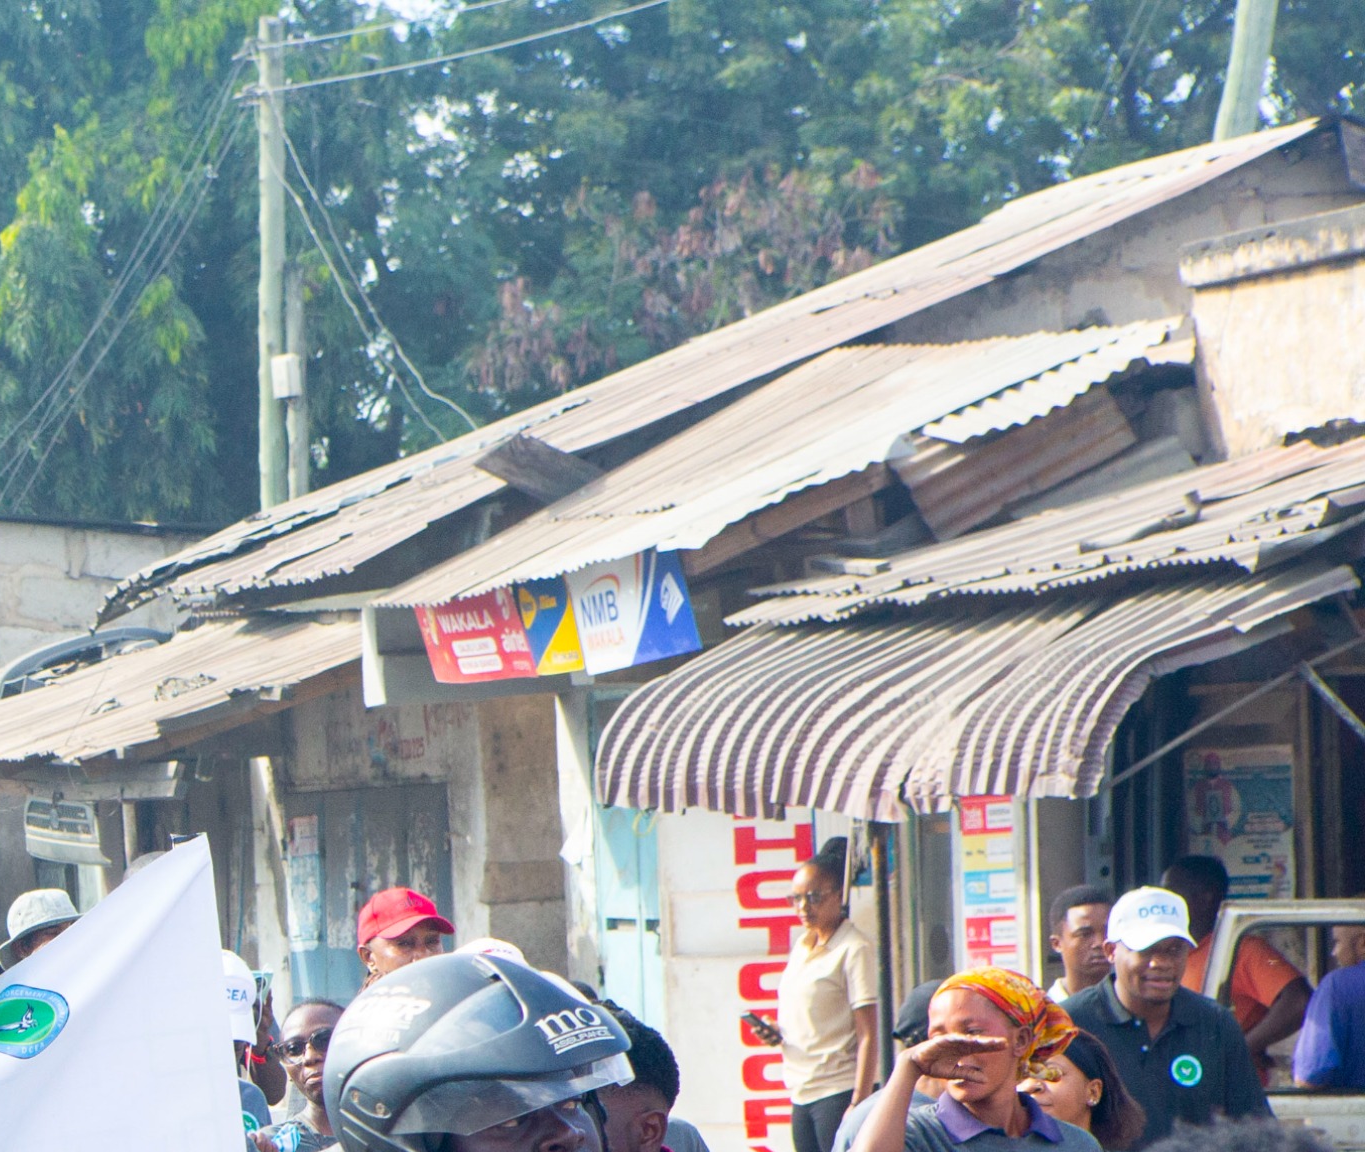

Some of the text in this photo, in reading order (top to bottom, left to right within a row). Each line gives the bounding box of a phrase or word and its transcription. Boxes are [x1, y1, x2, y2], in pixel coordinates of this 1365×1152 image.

[580, 589, 619, 628] NMB
[437, 609, 496, 634] WAKALA
[500, 628, 530, 653] airtel
[586, 627, 625, 648] WAKALA
[1138, 904, 1179, 919] DCEA
[534, 1007, 601, 1042] mo
